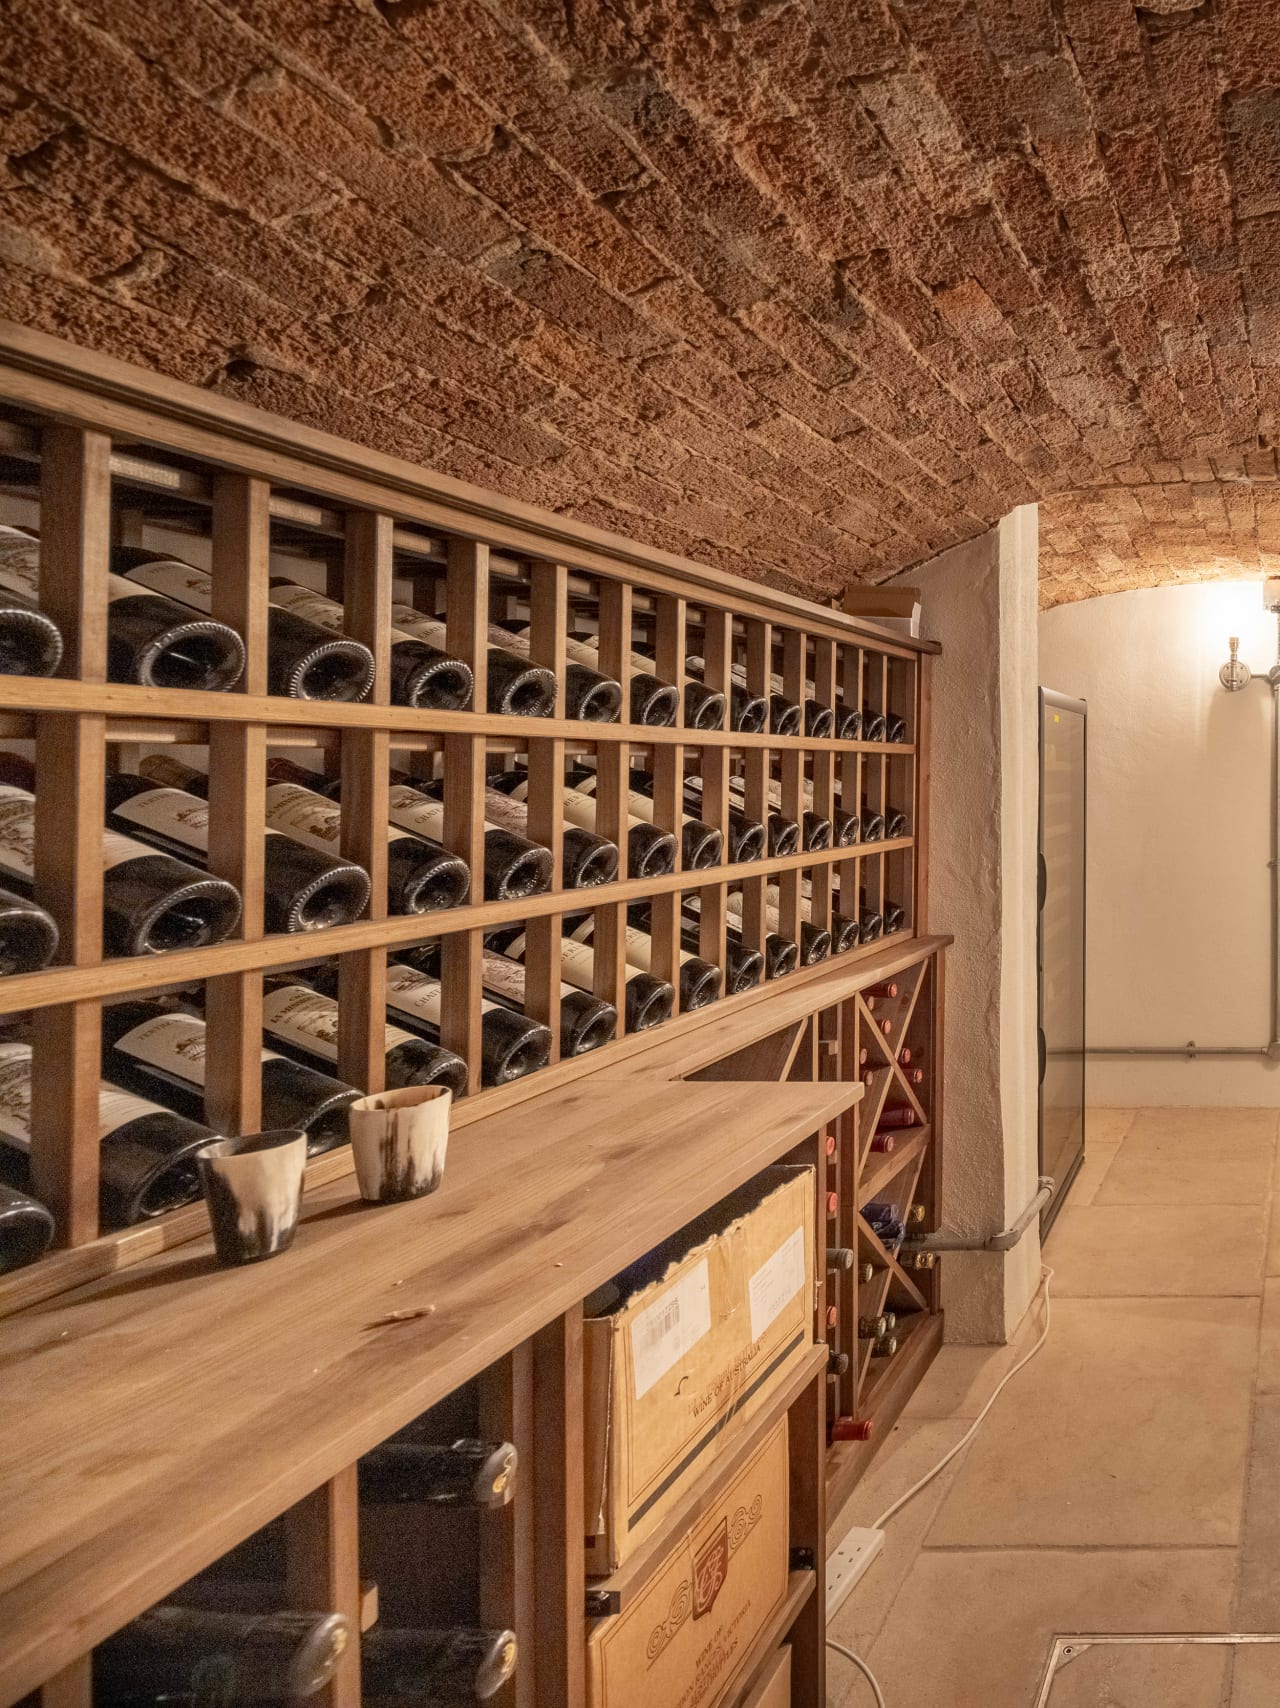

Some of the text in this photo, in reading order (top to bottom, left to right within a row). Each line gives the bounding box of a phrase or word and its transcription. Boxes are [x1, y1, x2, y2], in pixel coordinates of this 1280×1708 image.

[694, 1393, 712, 1417] WINE
[714, 1381, 725, 1397] OF
[726, 1344, 761, 1386] AUSTRALIA
